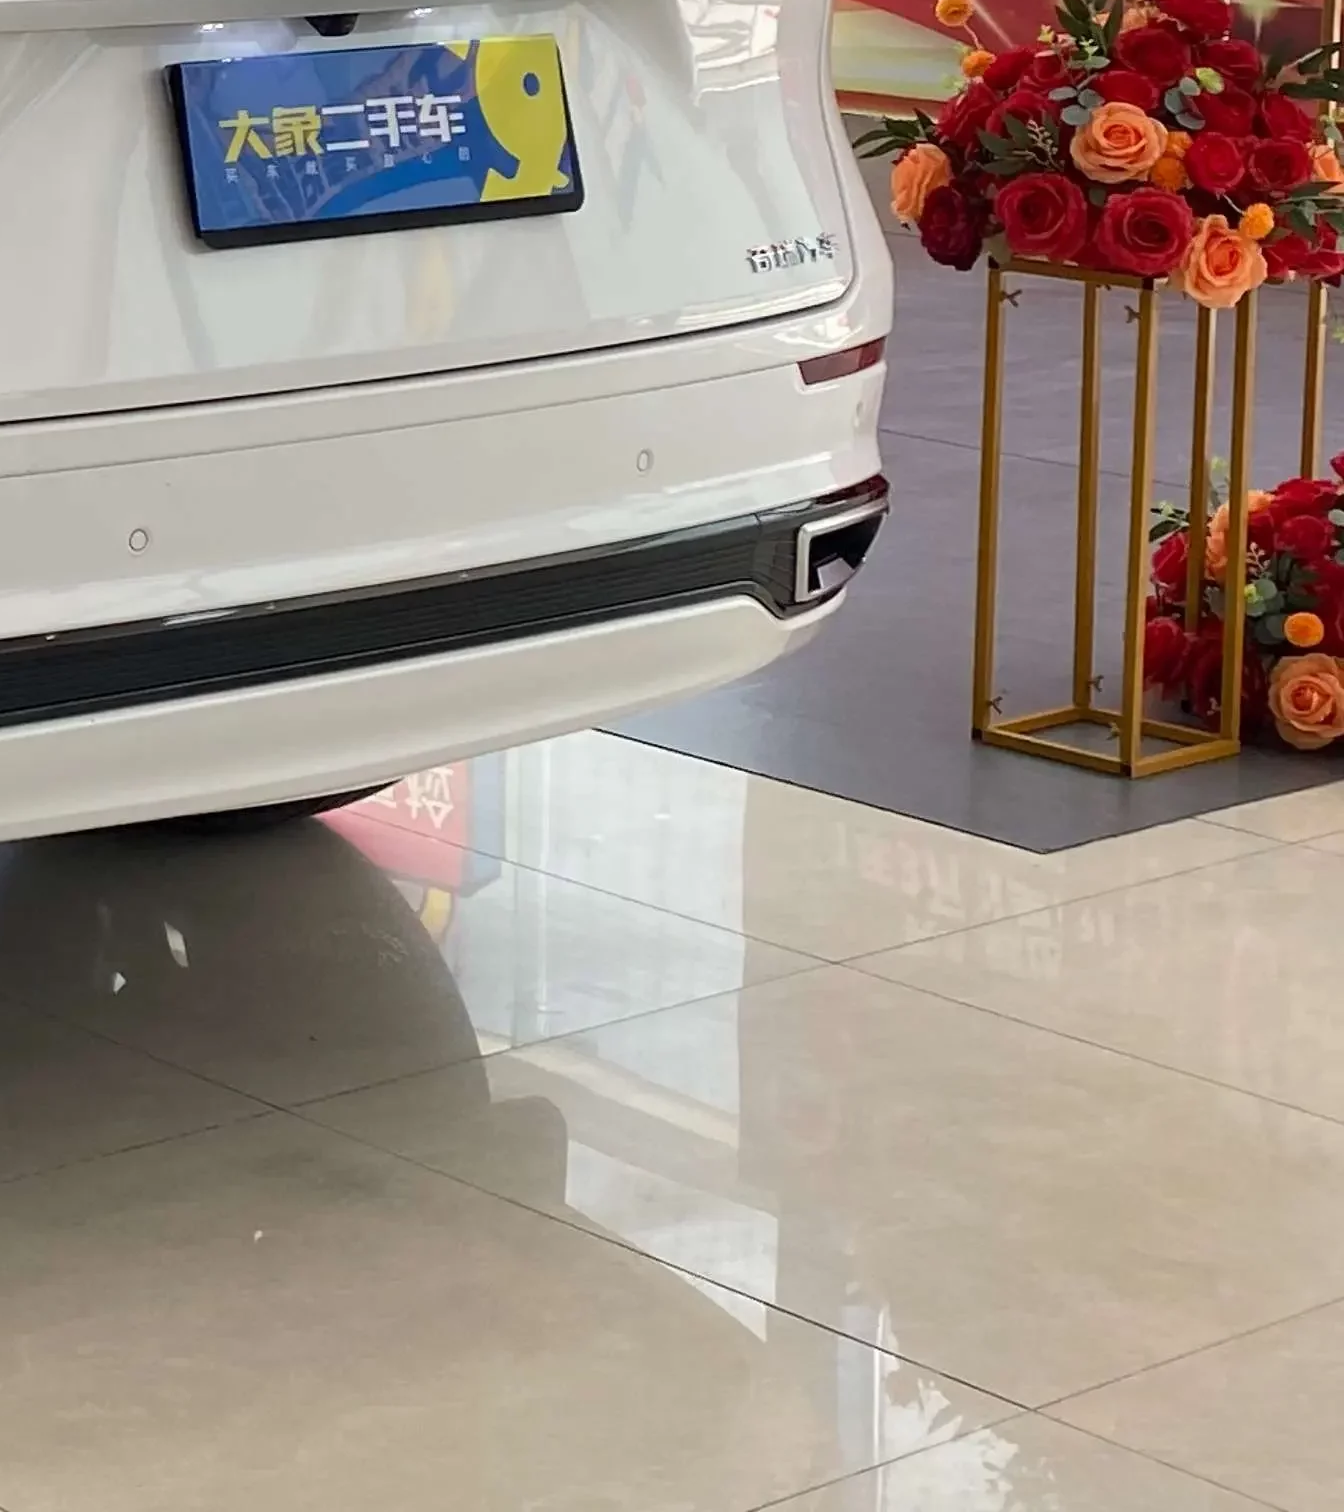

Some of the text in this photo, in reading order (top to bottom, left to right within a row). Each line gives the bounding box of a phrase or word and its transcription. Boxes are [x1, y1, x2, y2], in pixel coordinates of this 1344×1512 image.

[217, 92, 467, 164] 大象二手车
